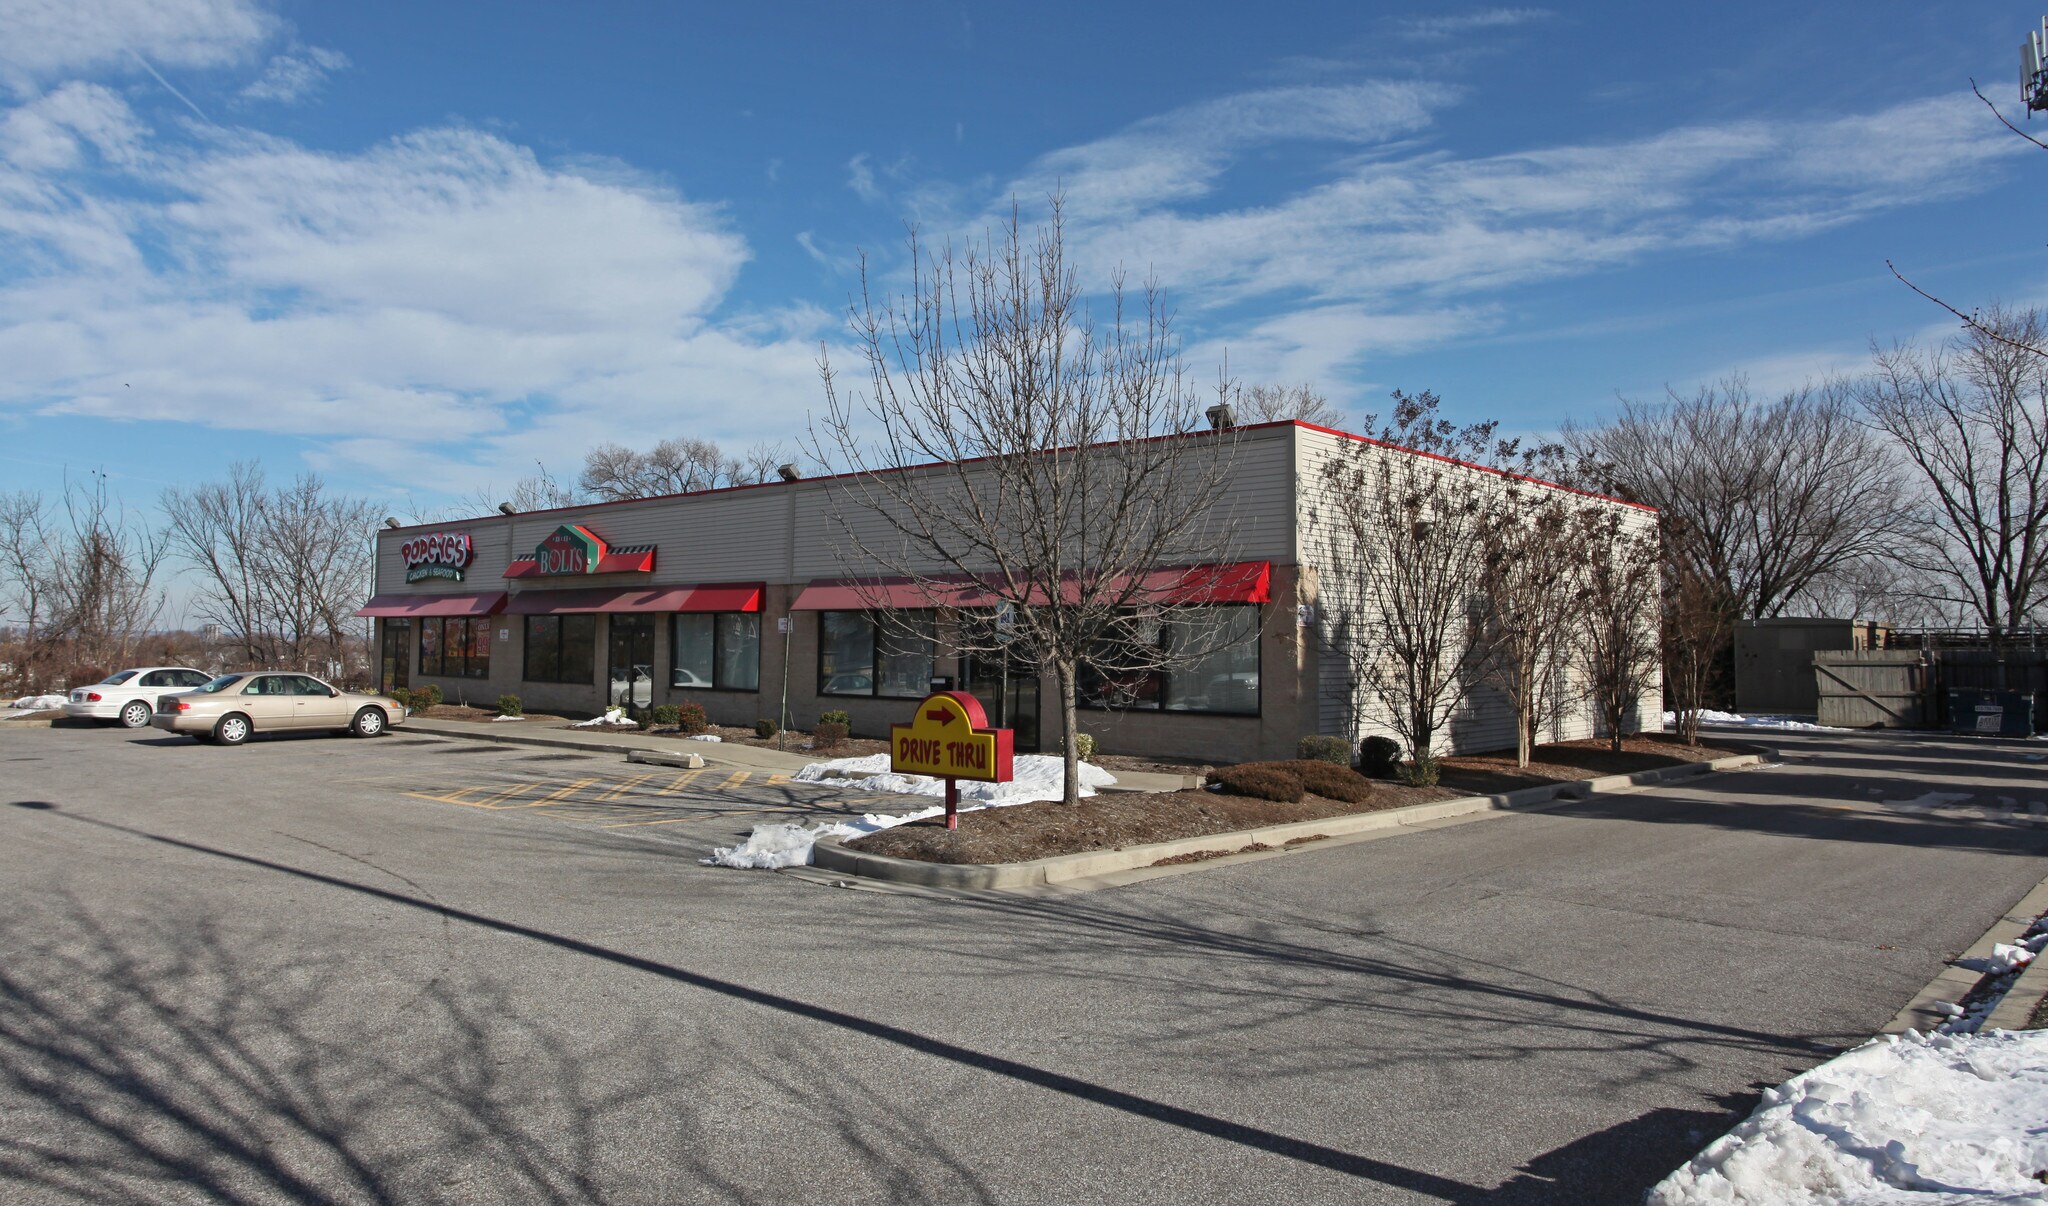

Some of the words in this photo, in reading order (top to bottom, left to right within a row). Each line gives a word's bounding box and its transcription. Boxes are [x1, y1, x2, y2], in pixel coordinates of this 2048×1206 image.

[401, 535, 466, 569] POPEYES
[409, 569, 428, 581] CHICKEN
[433, 567, 454, 578] SEAFOOD
[899, 737, 941, 765] DRIVE
[946, 741, 986, 769] THRU
